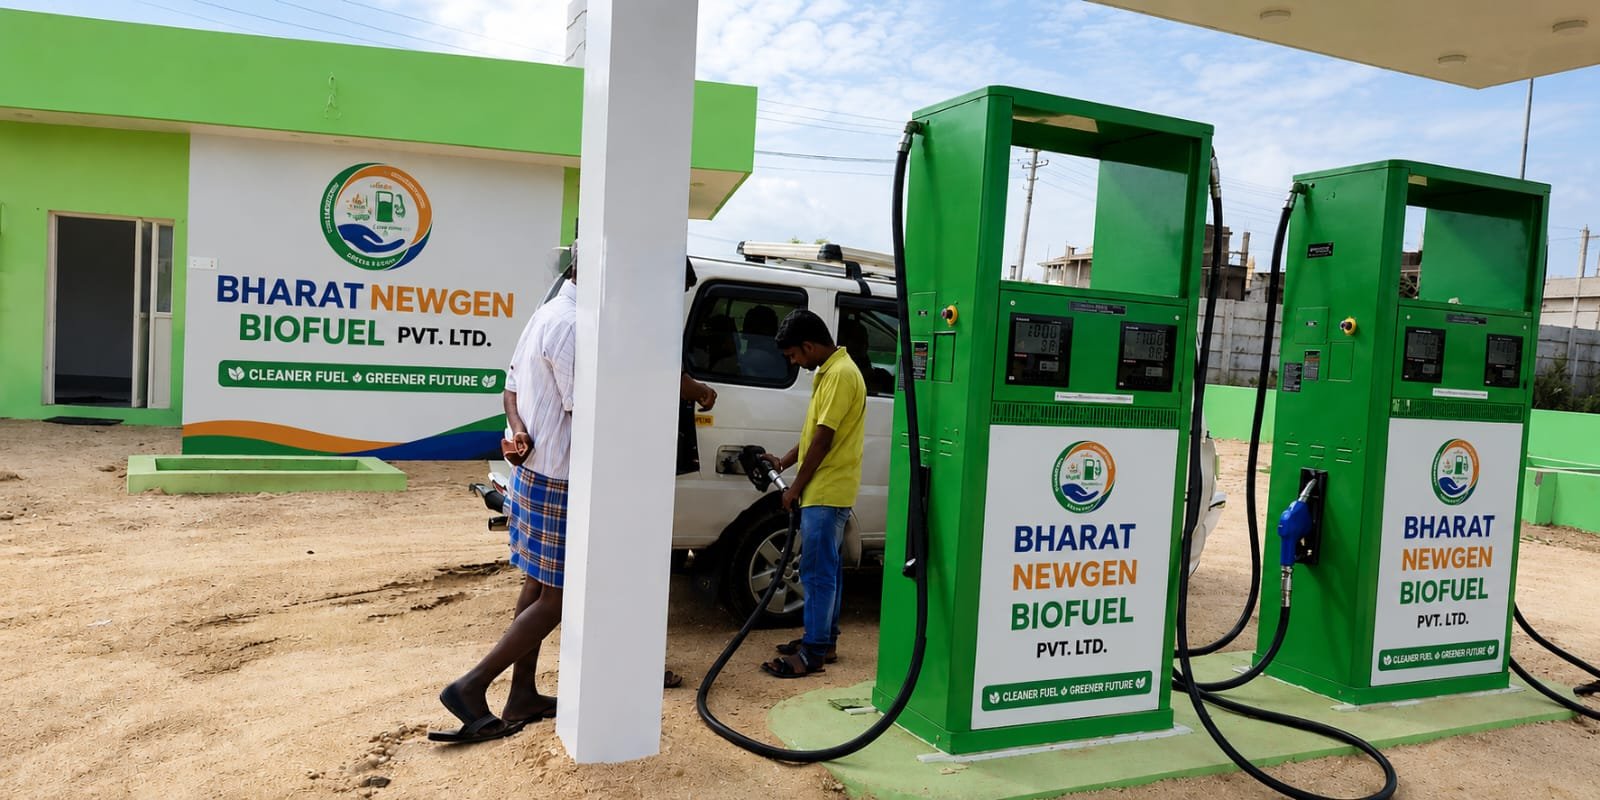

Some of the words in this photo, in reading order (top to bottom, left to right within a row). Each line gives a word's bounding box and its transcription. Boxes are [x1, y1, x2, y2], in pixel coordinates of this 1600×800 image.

[217, 275, 364, 309] BHARAT
[371, 285, 514, 318] NEWGEN
[240, 314, 384, 346] BIOFUEL
[398, 327, 443, 345] PVT.
[450, 329, 491, 347] LTD.
[249, 368, 311, 382] CLEANER
[316, 370, 348, 383] FUEL
[366, 372, 425, 385] GREENER
[430, 374, 477, 387] FUTURE
[1015, 524, 1136, 552] BHARAT
[1404, 515, 1495, 539] BHARAT
[1402, 546, 1492, 571] NEWGEN
[1013, 560, 1137, 590] NEWGEN
[1400, 577, 1488, 604] BIOFUEL
[1011, 597, 1133, 631] BIOFUEL
[1418, 614, 1442, 628] PVT.
[1446, 612, 1468, 626] LTD.
[1037, 641, 1071, 658] PVT.
[1076, 639, 1107, 655] LTD.
[1003, 689, 1038, 702] CLEANER
[1040, 687, 1058, 698] FUEL
[1070, 682, 1103, 695] GREENER
[1105, 679, 1133, 691] FUTURE
